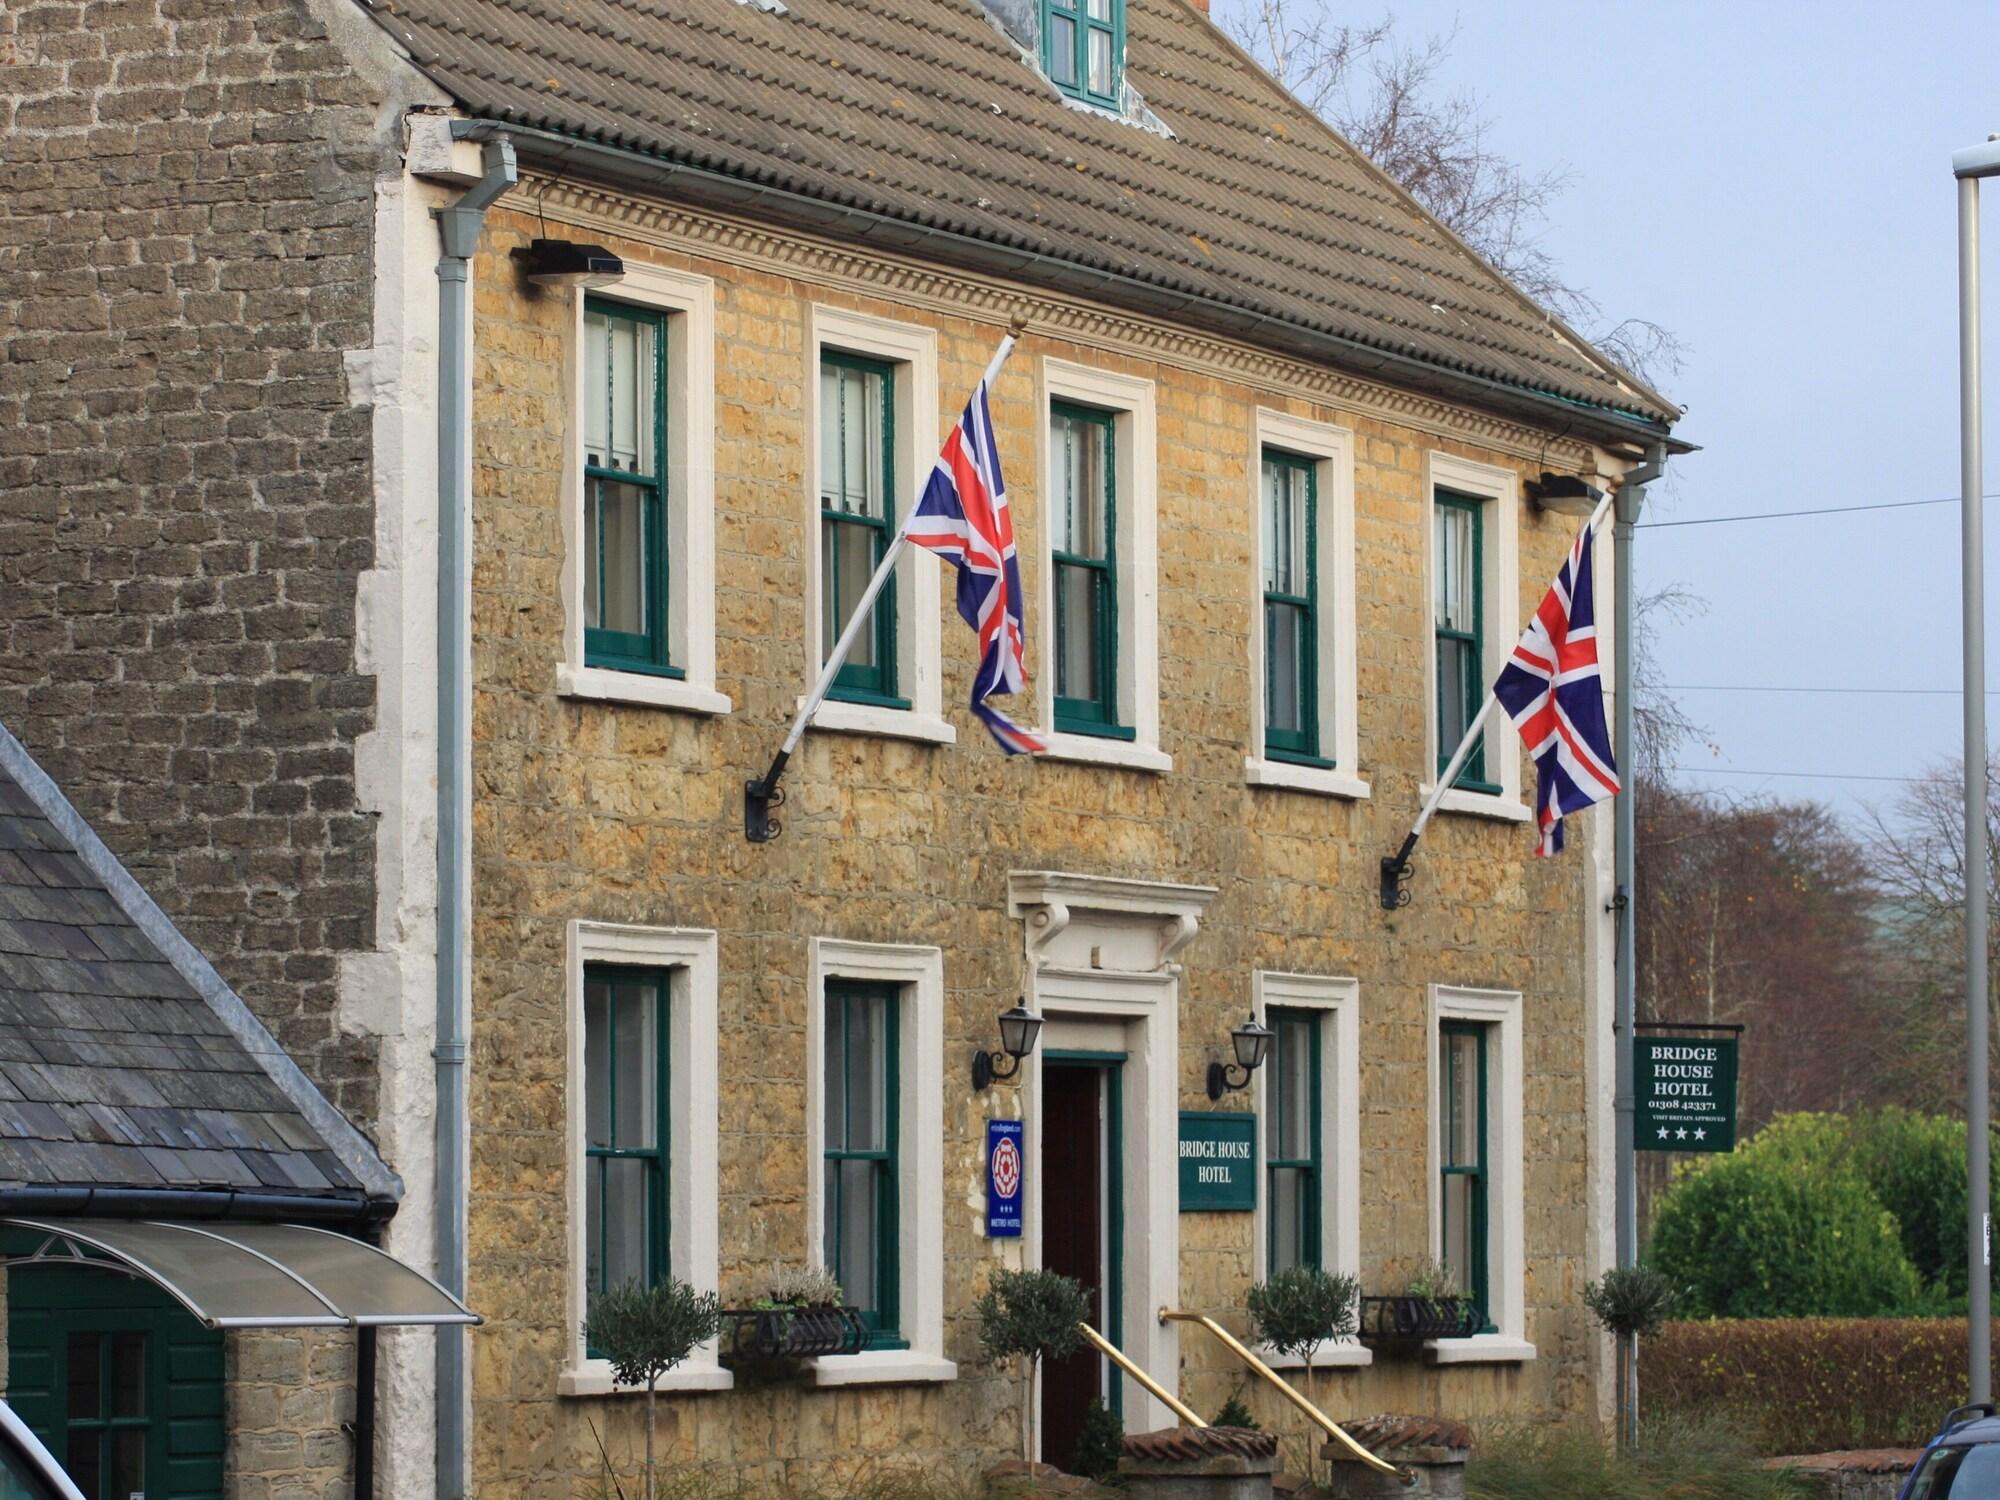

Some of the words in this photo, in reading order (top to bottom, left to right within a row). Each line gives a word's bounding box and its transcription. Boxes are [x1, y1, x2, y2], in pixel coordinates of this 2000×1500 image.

[1651, 1046, 1717, 1061] BRIDGE
[1653, 1064, 1713, 1079] HOUSE
[1654, 1082, 1712, 1097] HOTEL
[1648, 1099, 1679, 1110] 01308
[1681, 1101, 1716, 1111] 423371
[1179, 1140, 1216, 1158] BRIDGE
[1218, 1141, 1250, 1159] HOUSE
[1198, 1166, 1231, 1183] HOTEL
